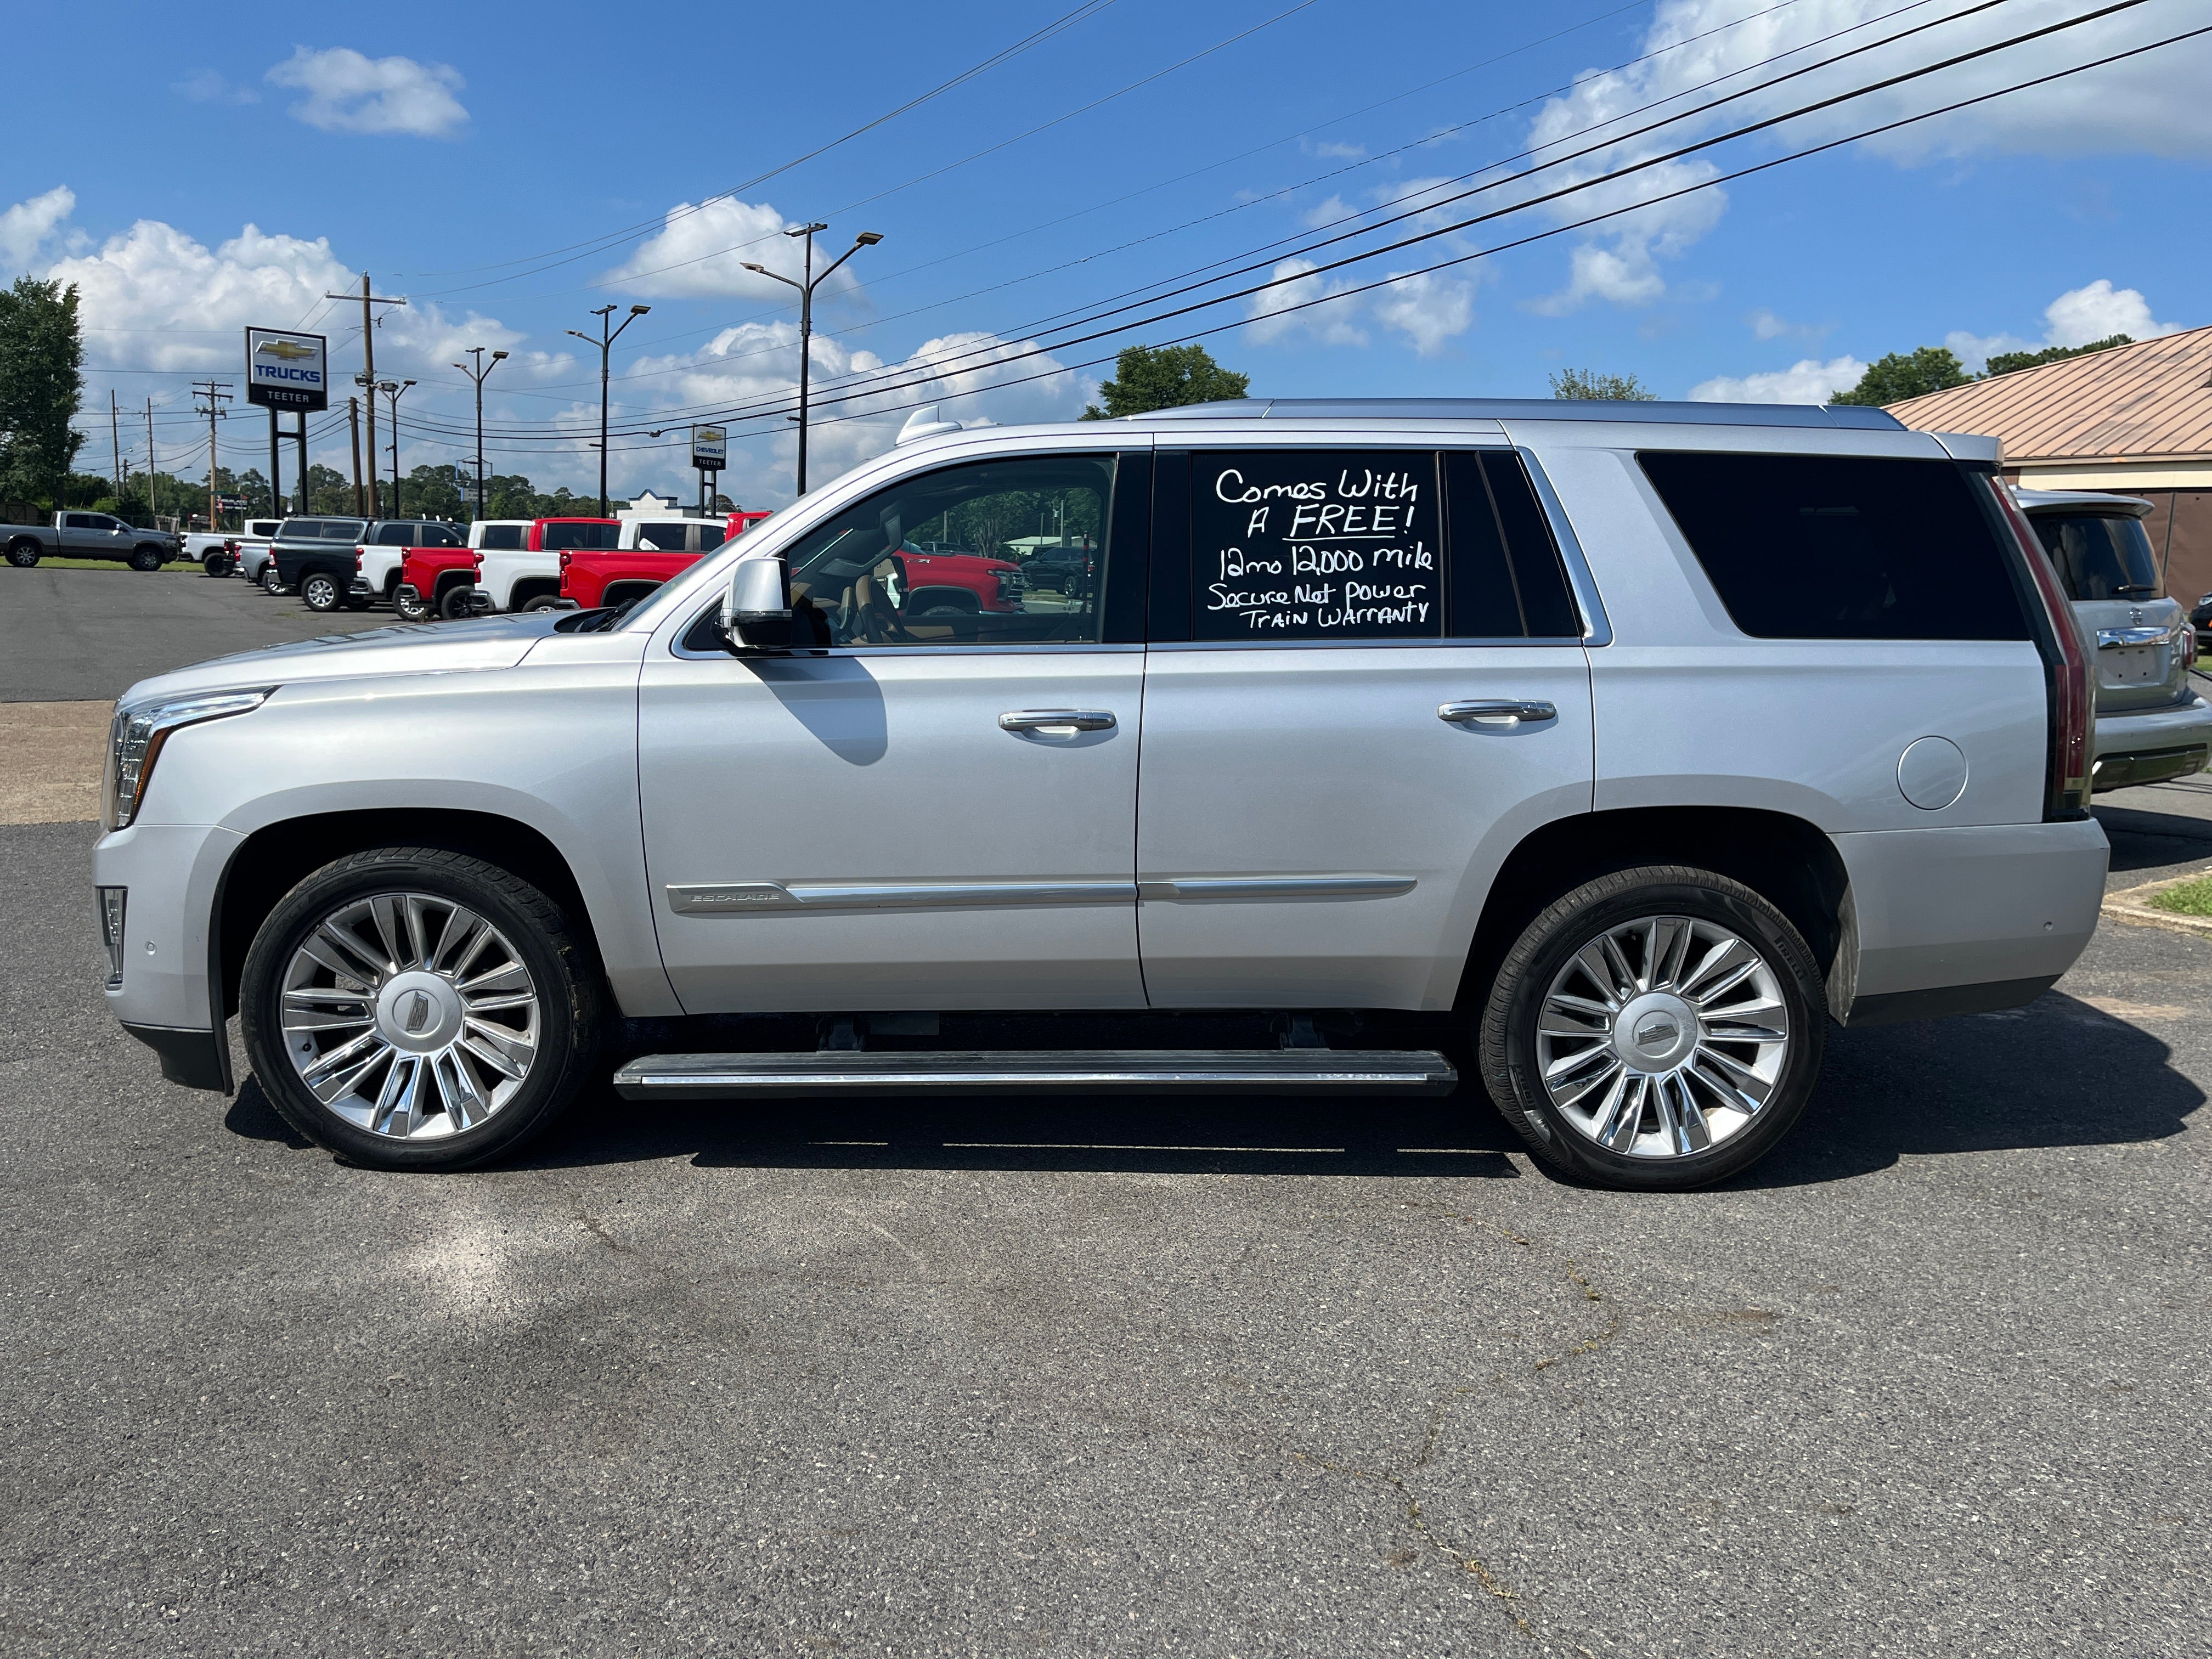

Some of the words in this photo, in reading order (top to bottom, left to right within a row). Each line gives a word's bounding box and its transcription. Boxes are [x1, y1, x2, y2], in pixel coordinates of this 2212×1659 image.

[255, 364, 320, 383] TRUCKS
[267, 391, 309, 403] TEETER
[696, 446, 724, 455] CHEVROLET
[1216, 469, 1327, 503] Comes
[1338, 469, 1418, 502] With
[1247, 506, 1269, 538] A
[1290, 503, 1414, 537] FREE!
[1220, 547, 1282, 581] 12mo
[1291, 545, 1364, 576] 12,000
[1373, 541, 1434, 571] mile
[1207, 583, 1291, 610] Secure
[690, 894, 780, 902] ESCALADE
